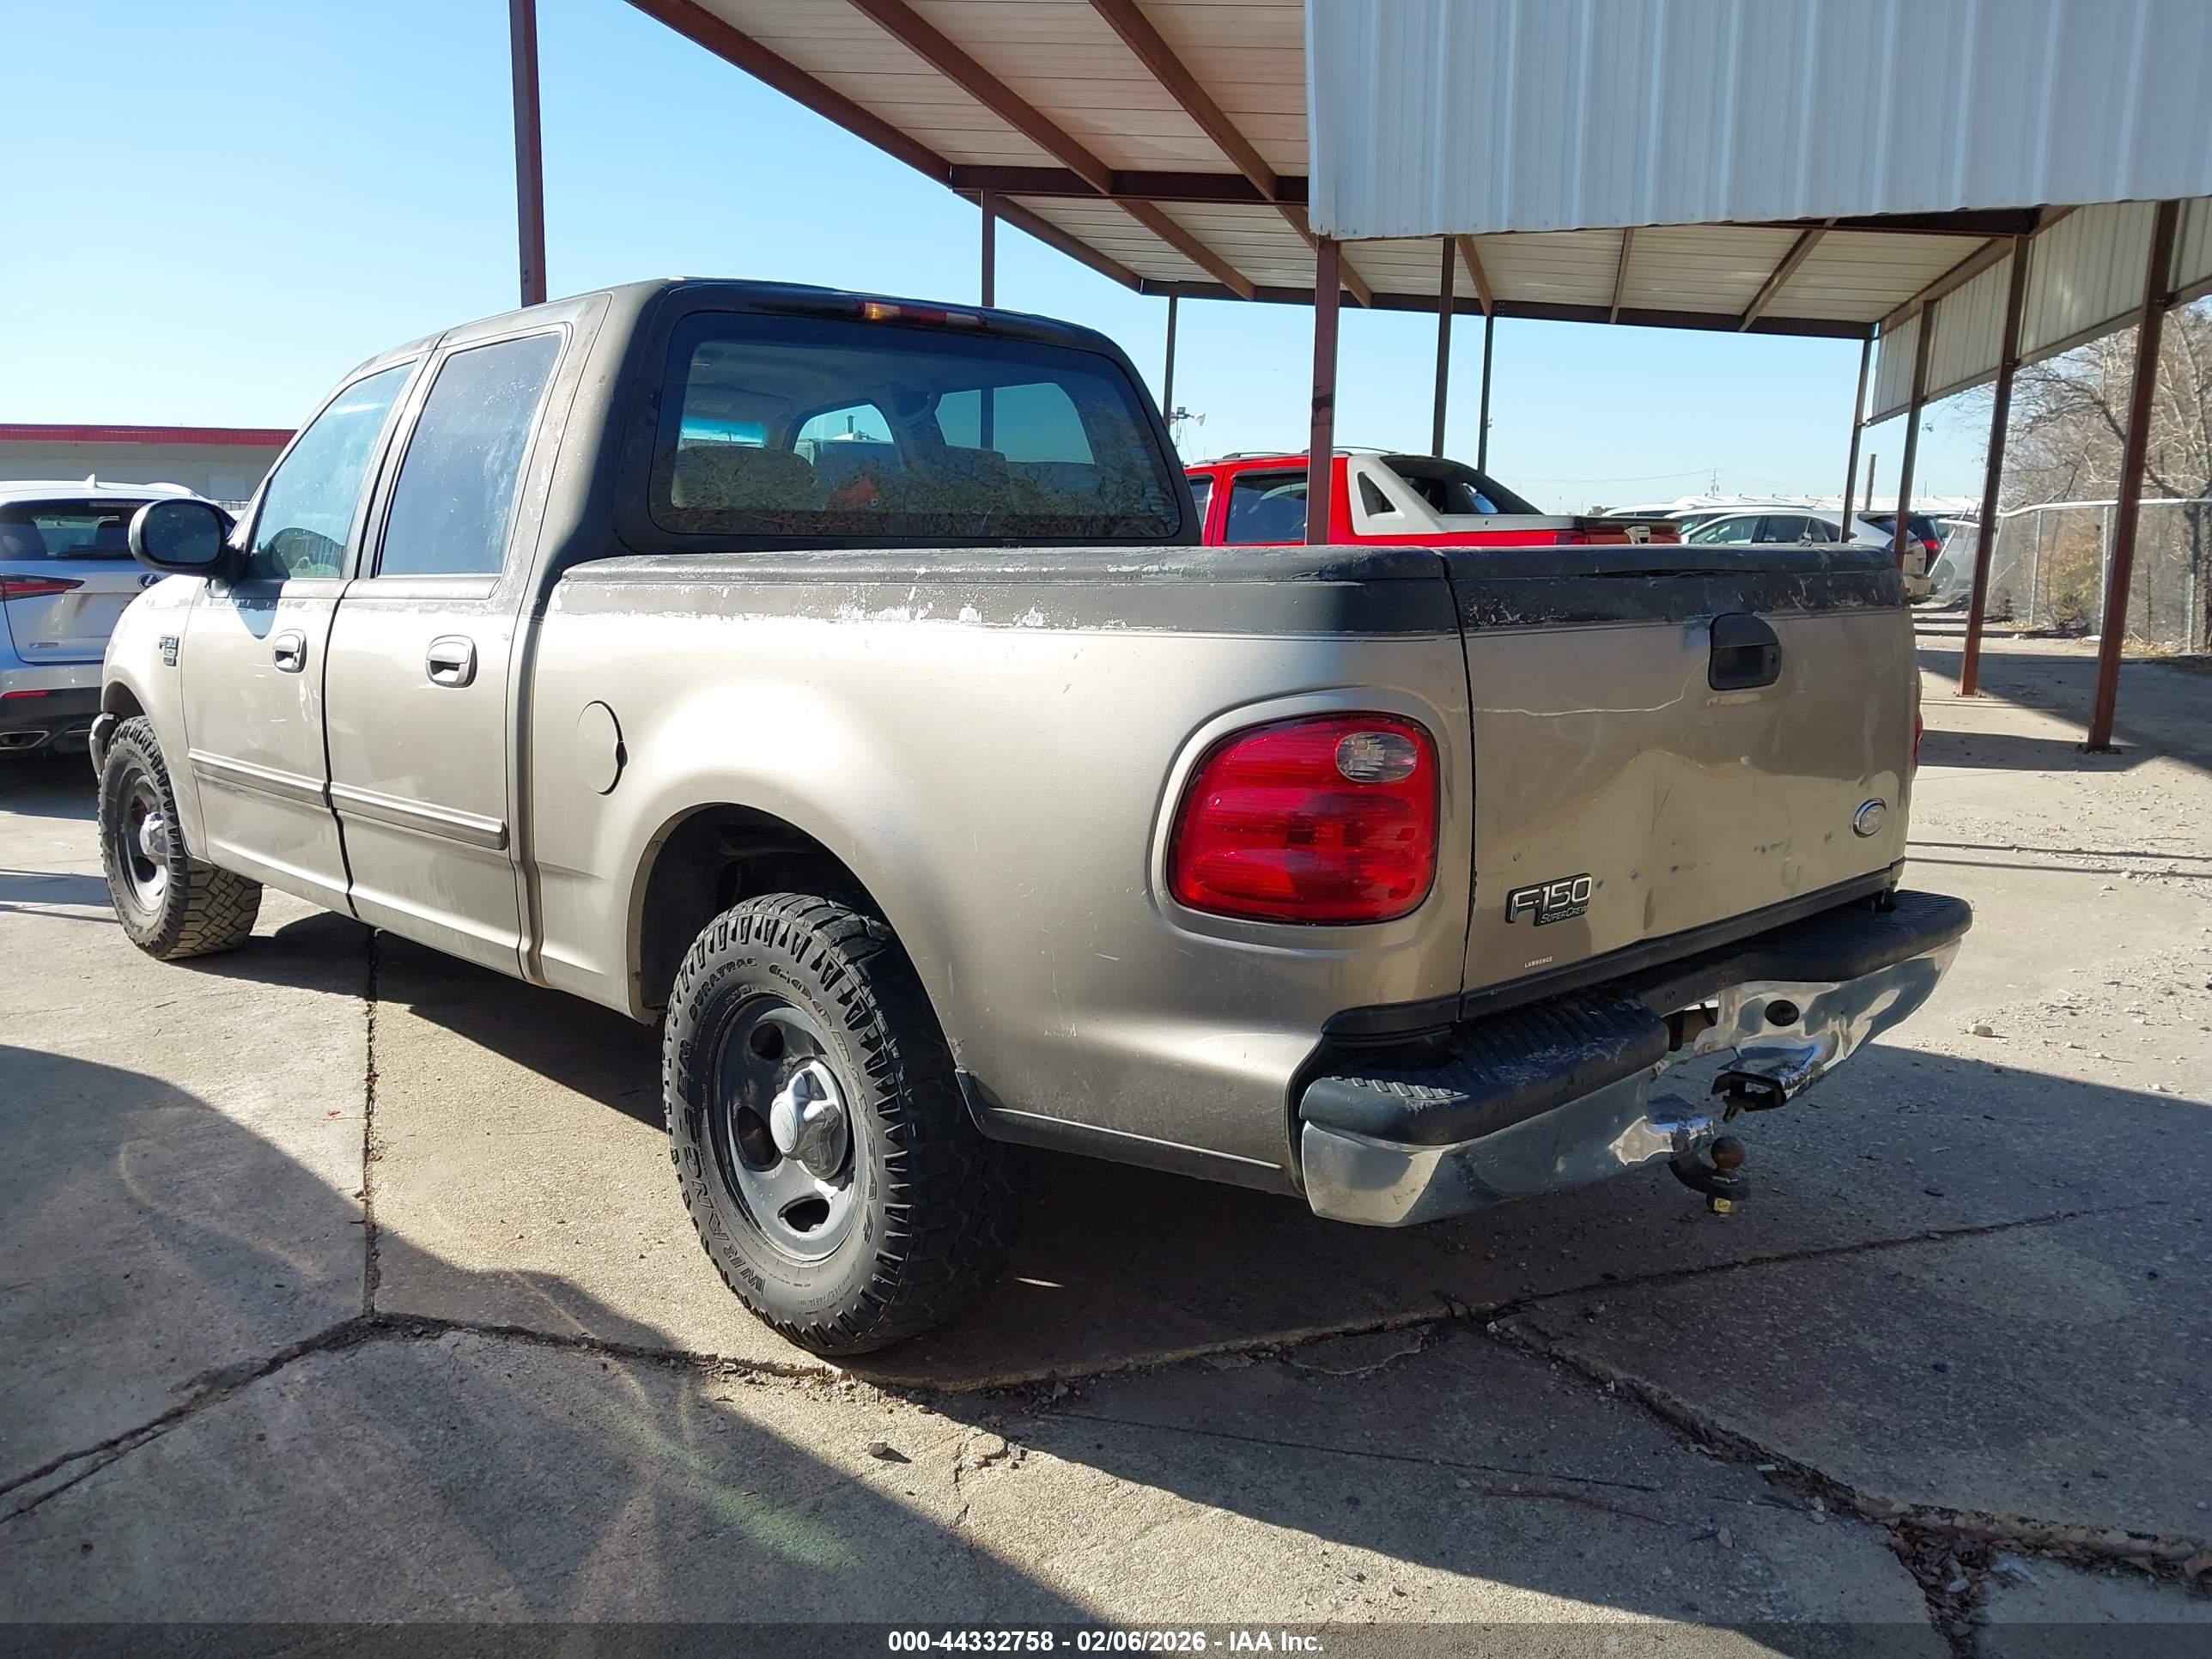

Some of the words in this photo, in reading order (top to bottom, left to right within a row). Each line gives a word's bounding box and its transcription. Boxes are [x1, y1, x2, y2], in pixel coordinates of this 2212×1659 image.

[1510, 876, 1592, 921] F-150
[690, 957, 757, 1023] DURATRAC
[677, 1037, 765, 1296] WRANGLER
